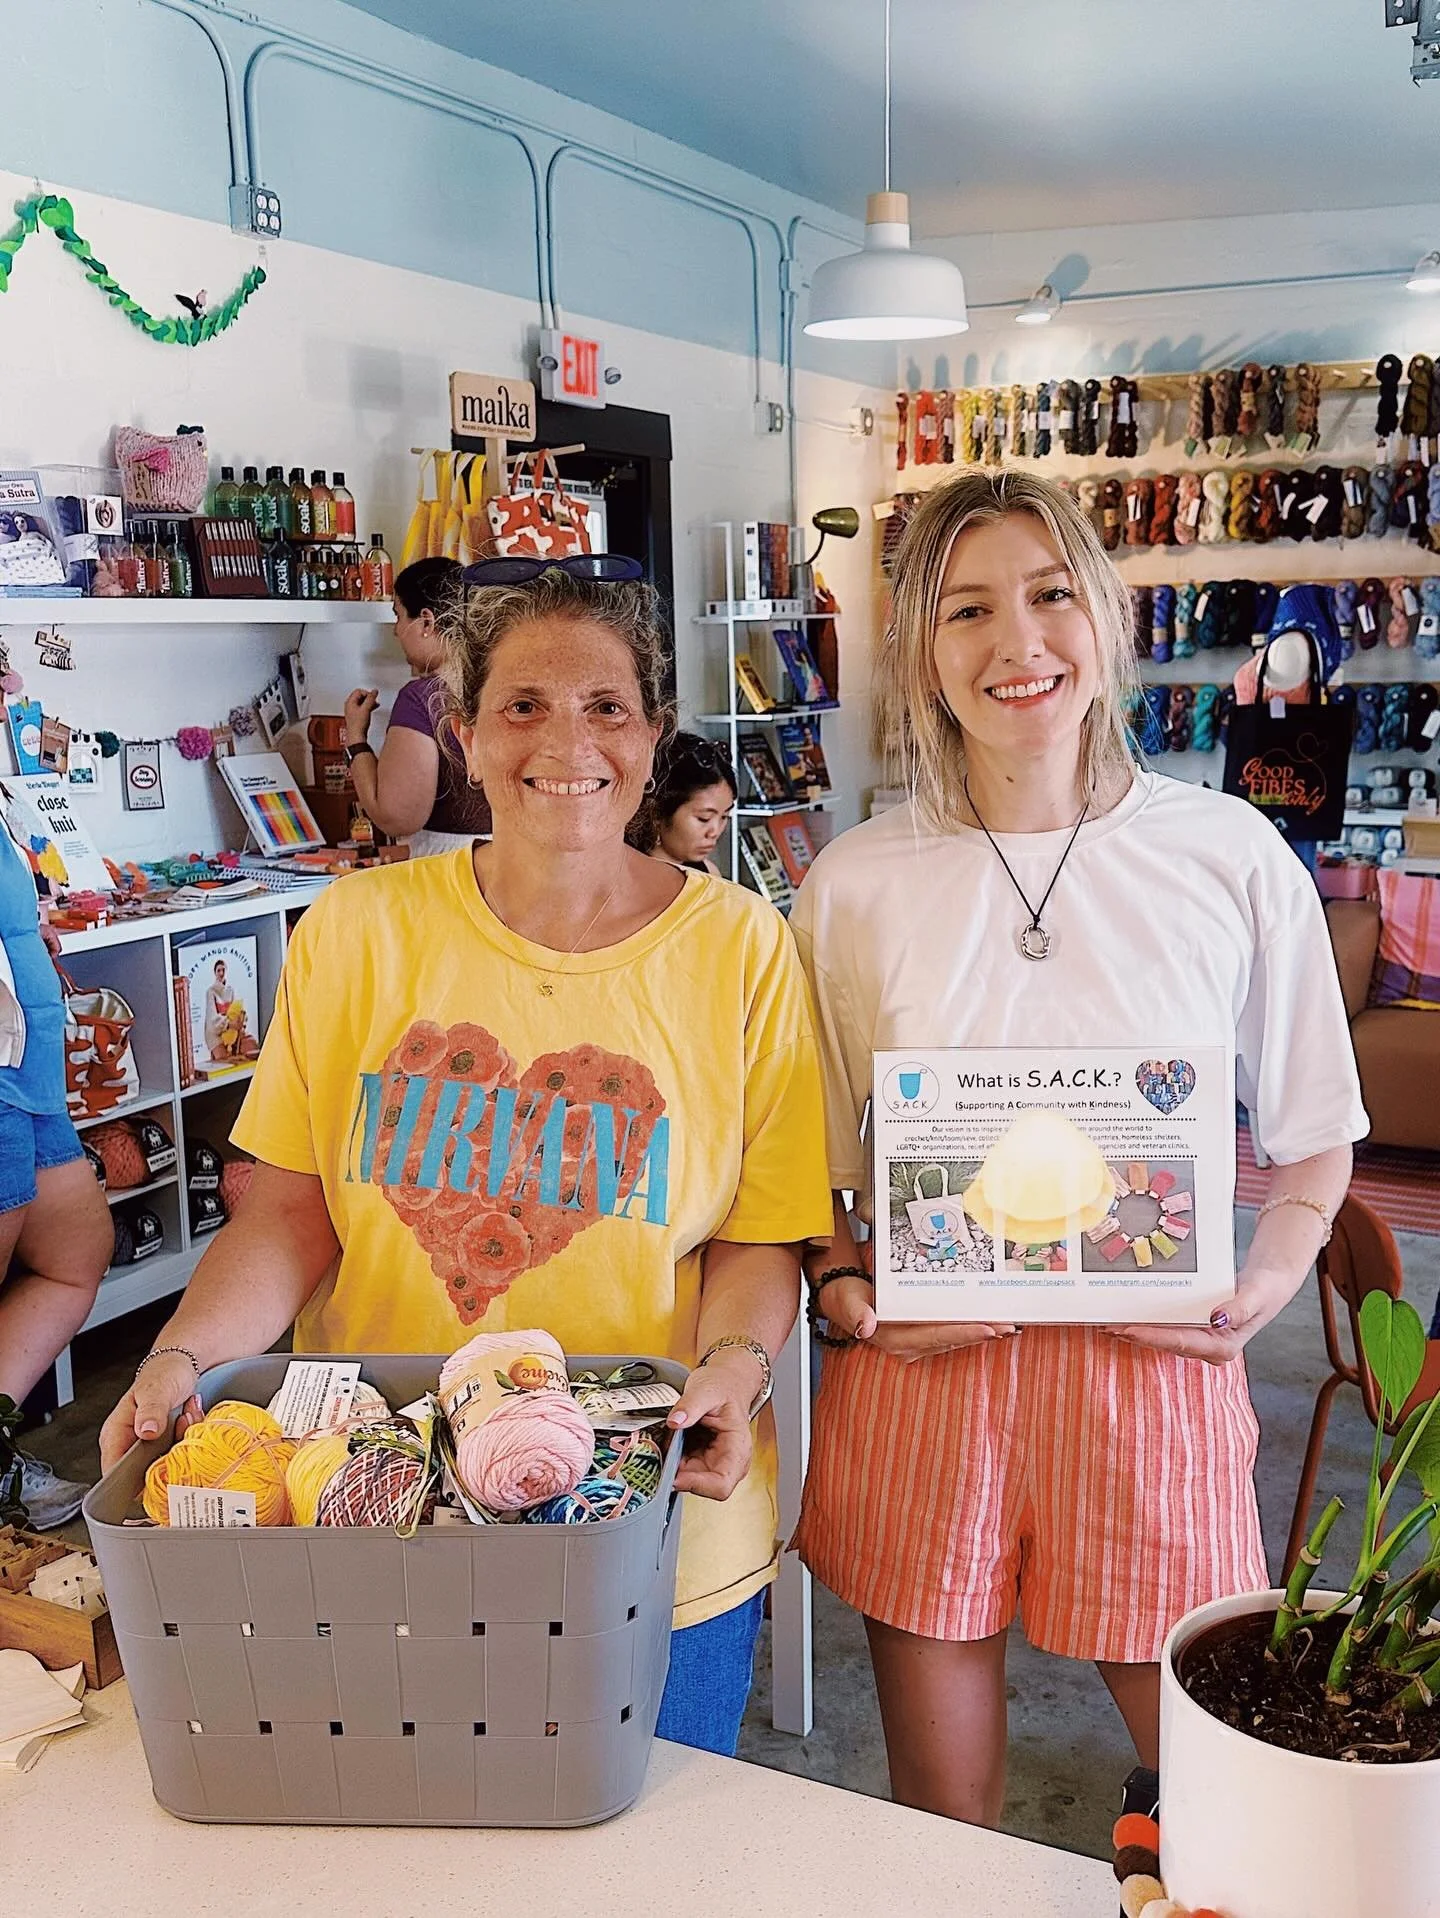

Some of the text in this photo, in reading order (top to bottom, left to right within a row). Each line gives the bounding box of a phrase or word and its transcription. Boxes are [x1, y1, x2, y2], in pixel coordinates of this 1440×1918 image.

[562, 335, 600, 400] EXIT
[461, 386, 531, 429] maika
[7, 489, 36, 499] Sutra
[298, 497, 310, 534] soak
[275, 559, 291, 595] soak
[370, 564, 381, 597] soak
[1238, 757, 1295, 786] GOOD
[1248, 778, 1306, 797] FIBES
[37, 795, 69, 812] close
[48, 816, 78, 835] knit
[957, 1069, 1122, 1088] What is S.A.C.K.?
[893, 1101, 928, 1110] SACK
[955, 1100, 1131, 1111] (Supporting A Community with Kindness)
[345, 1073, 669, 1227] NIRVANA
